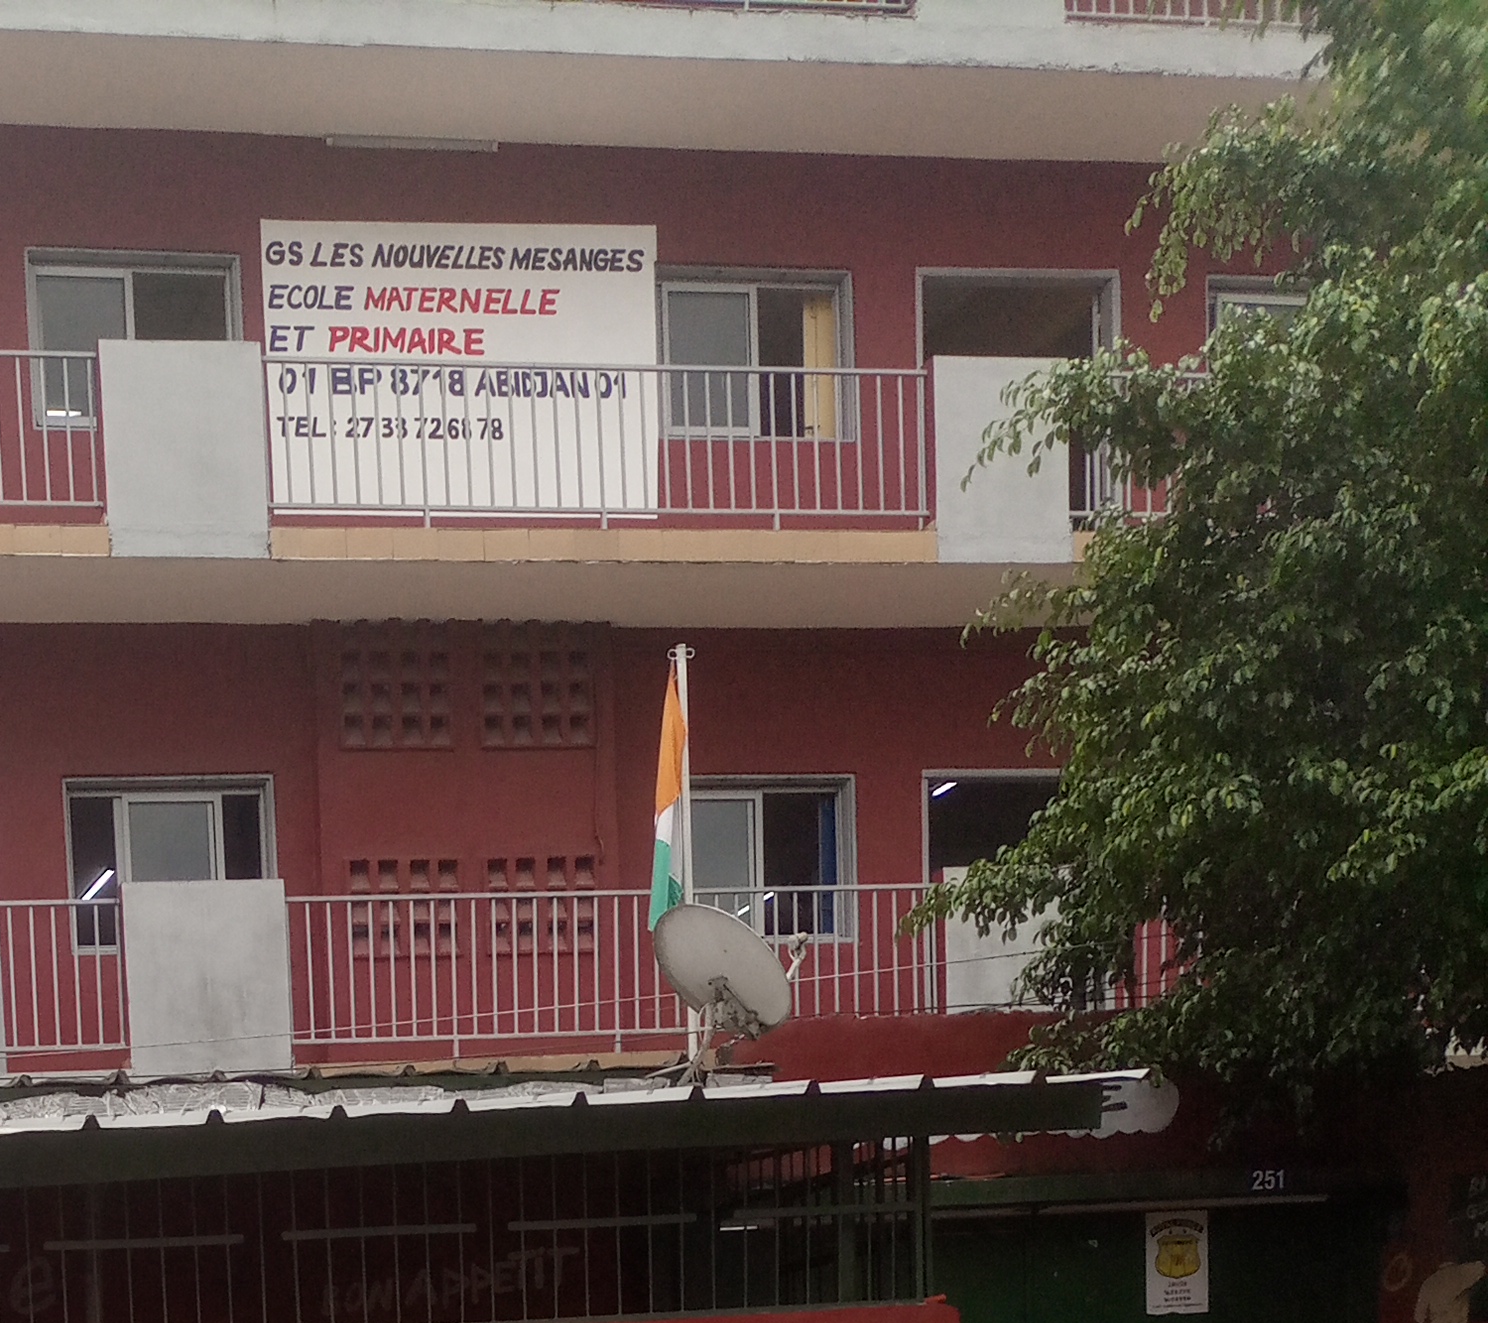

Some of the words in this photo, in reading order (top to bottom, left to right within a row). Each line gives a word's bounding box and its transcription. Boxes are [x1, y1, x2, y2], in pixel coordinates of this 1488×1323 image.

[265, 241, 303, 266] GS
[309, 242, 364, 267] LES
[371, 243, 505, 270] NOUVELLES
[509, 247, 644, 272] MESANGES
[268, 284, 354, 310] ECOLE
[364, 286, 560, 315] MATERNELLE
[269, 325, 315, 352] ET
[328, 326, 485, 355] PRIMAIRE
[279, 367, 317, 395] 01
[331, 367, 382, 395] BP
[475, 370, 590, 399] ABIDJAN
[1251, 1169, 1285, 1191] 251
